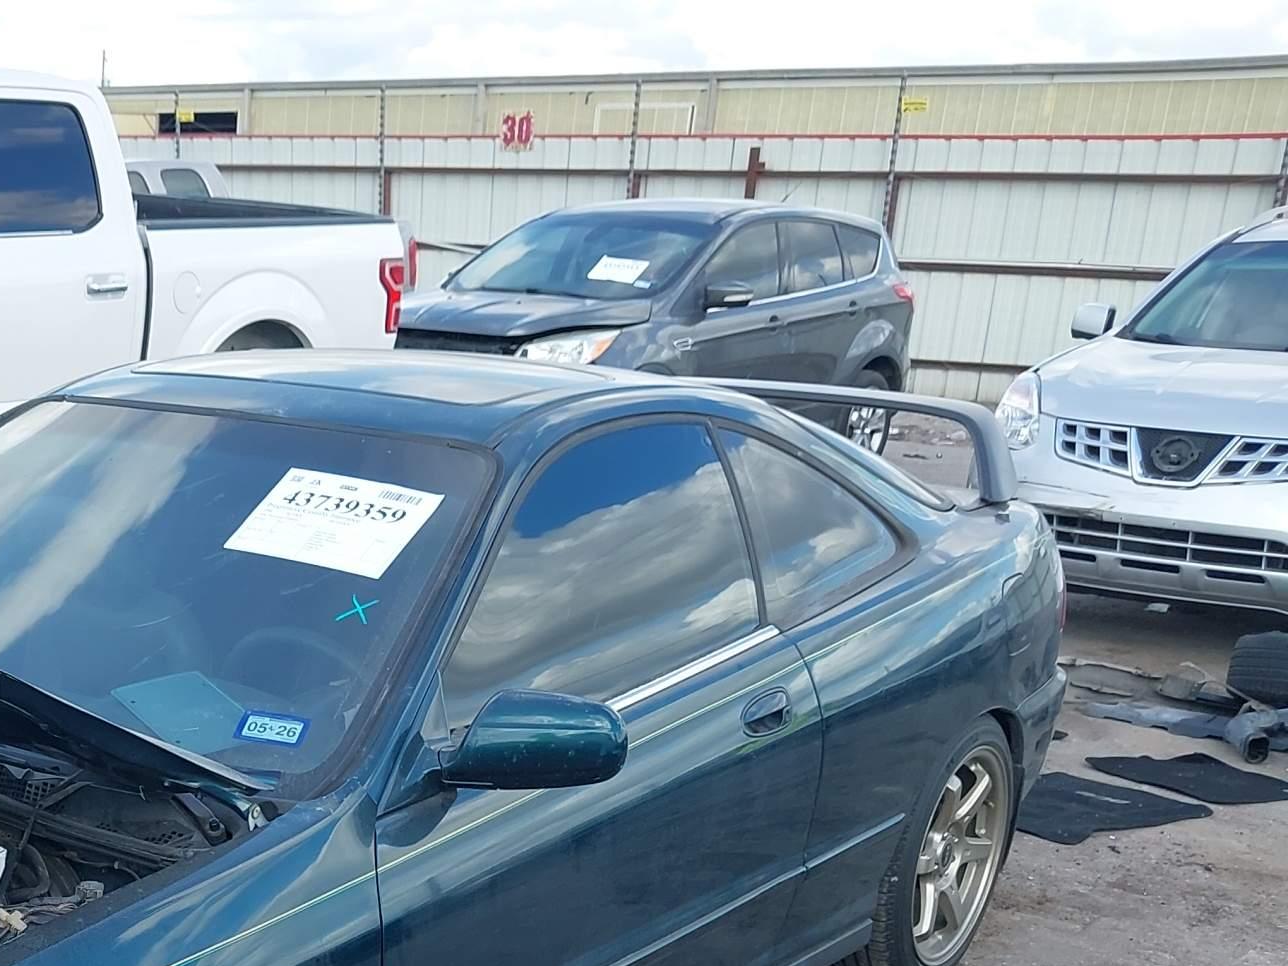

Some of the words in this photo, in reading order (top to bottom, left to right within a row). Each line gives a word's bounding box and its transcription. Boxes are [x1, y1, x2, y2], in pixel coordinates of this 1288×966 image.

[502, 113, 532, 145] 30
[283, 489, 407, 524] 43739359
[247, 721, 269, 734] 05
[275, 725, 298, 738] 26
